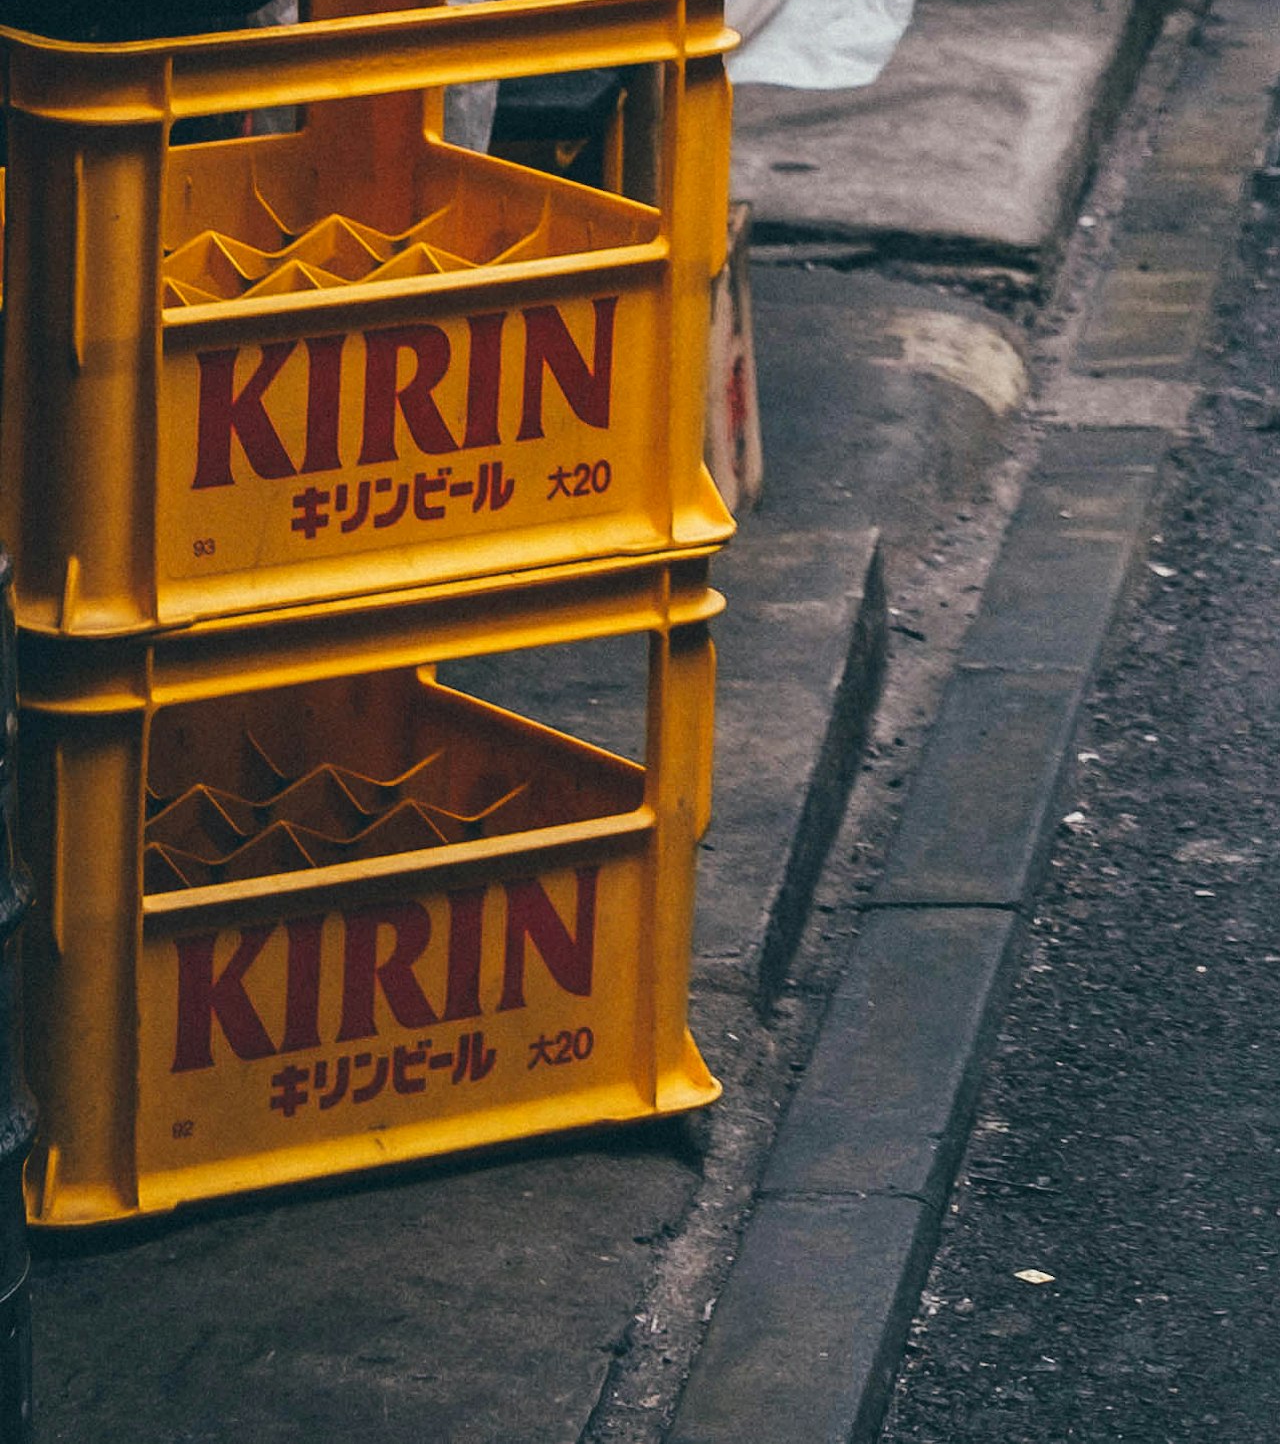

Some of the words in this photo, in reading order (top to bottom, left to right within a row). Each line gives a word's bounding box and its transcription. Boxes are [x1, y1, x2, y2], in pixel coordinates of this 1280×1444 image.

[193, 298, 618, 490] KIRIN
[290, 461, 516, 540] キリンビール
[545, 458, 613, 502] 大20
[171, 869, 598, 1073] KIRIN
[268, 1029, 498, 1118] キリンビール
[526, 1027, 595, 1071] 大20
